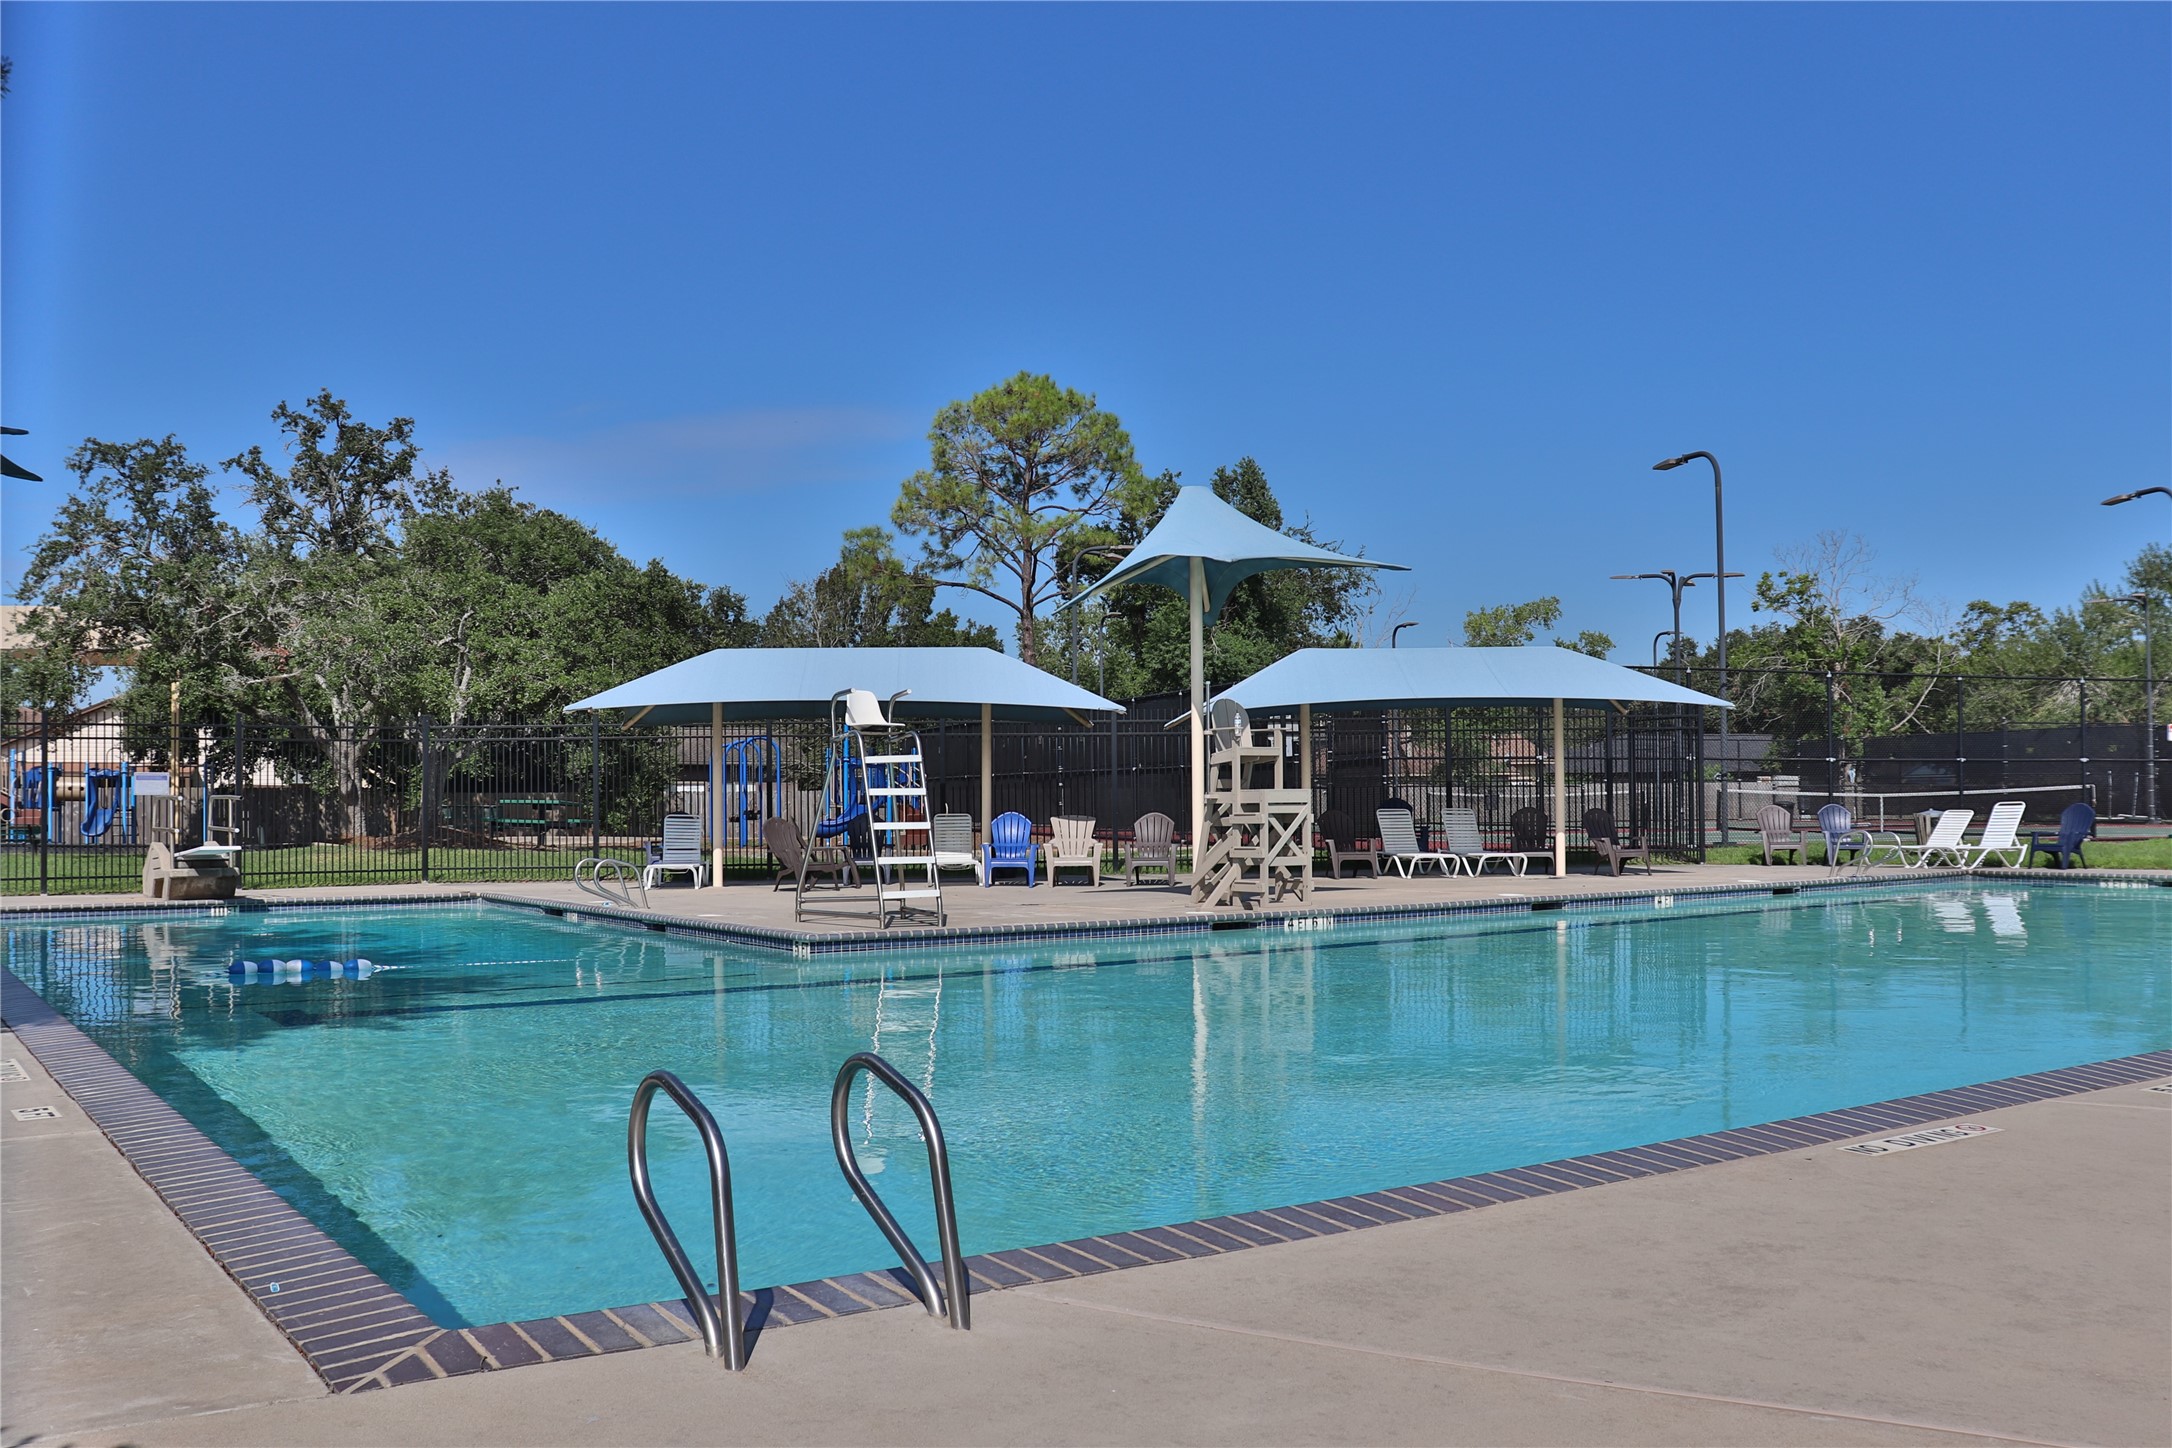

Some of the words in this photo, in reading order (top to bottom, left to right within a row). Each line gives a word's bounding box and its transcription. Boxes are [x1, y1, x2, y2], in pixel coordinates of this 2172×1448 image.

[1287, 917, 1295, 928] 4
[1844, 1145, 1889, 1155] NO
[1883, 1128, 1969, 1148] DIVING
